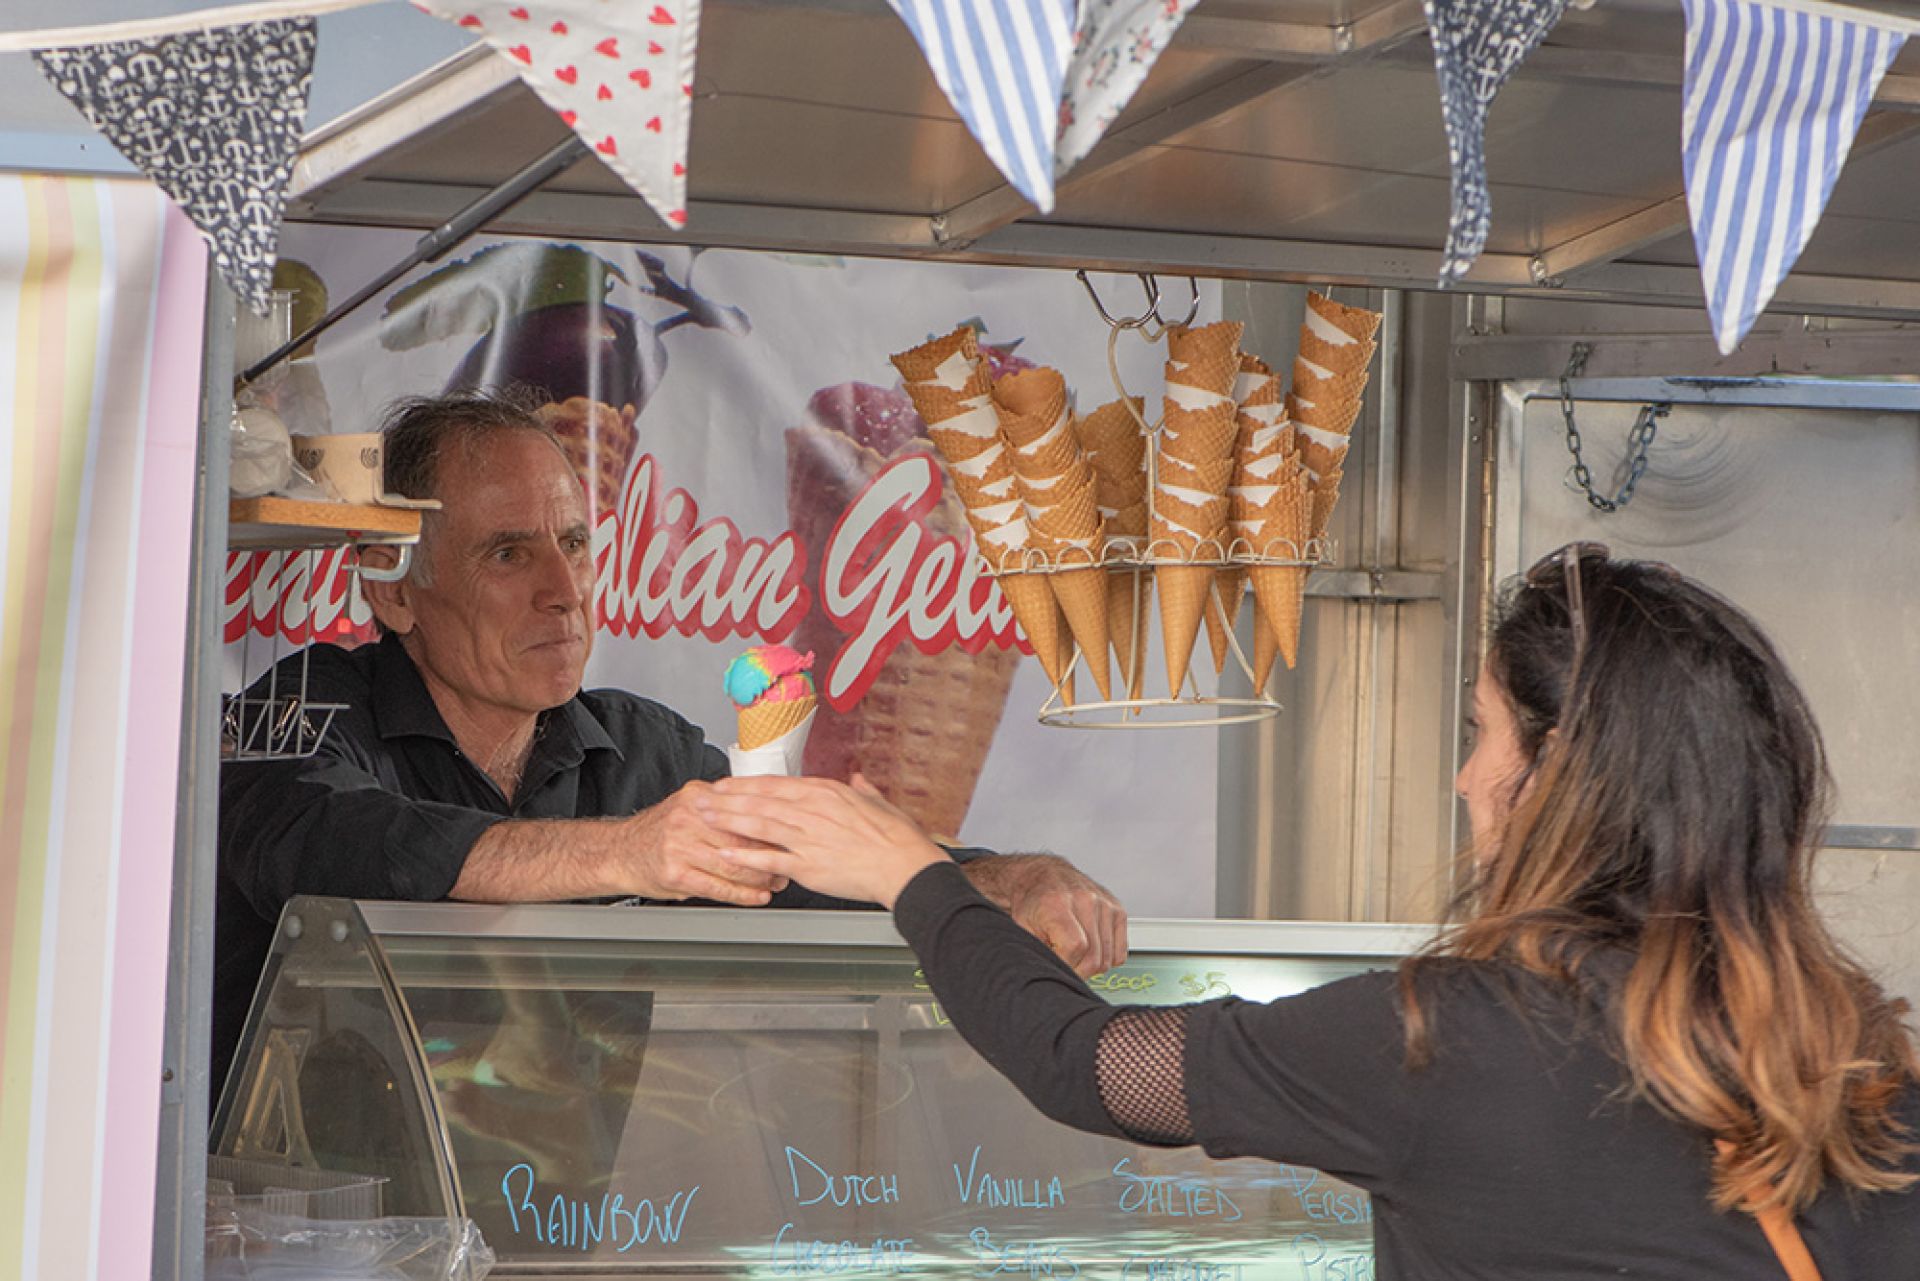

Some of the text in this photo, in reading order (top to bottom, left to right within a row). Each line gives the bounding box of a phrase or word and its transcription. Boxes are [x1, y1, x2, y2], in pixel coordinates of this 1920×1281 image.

[588, 453, 810, 642] alian
[502, 1163, 701, 1252] RAINBOW
[785, 1146, 899, 1207] DUTCH
[953, 1144, 1066, 1209] VANILLA
[1112, 1157, 1243, 1222] SALTED
[969, 1226, 1082, 1281] BEANS
